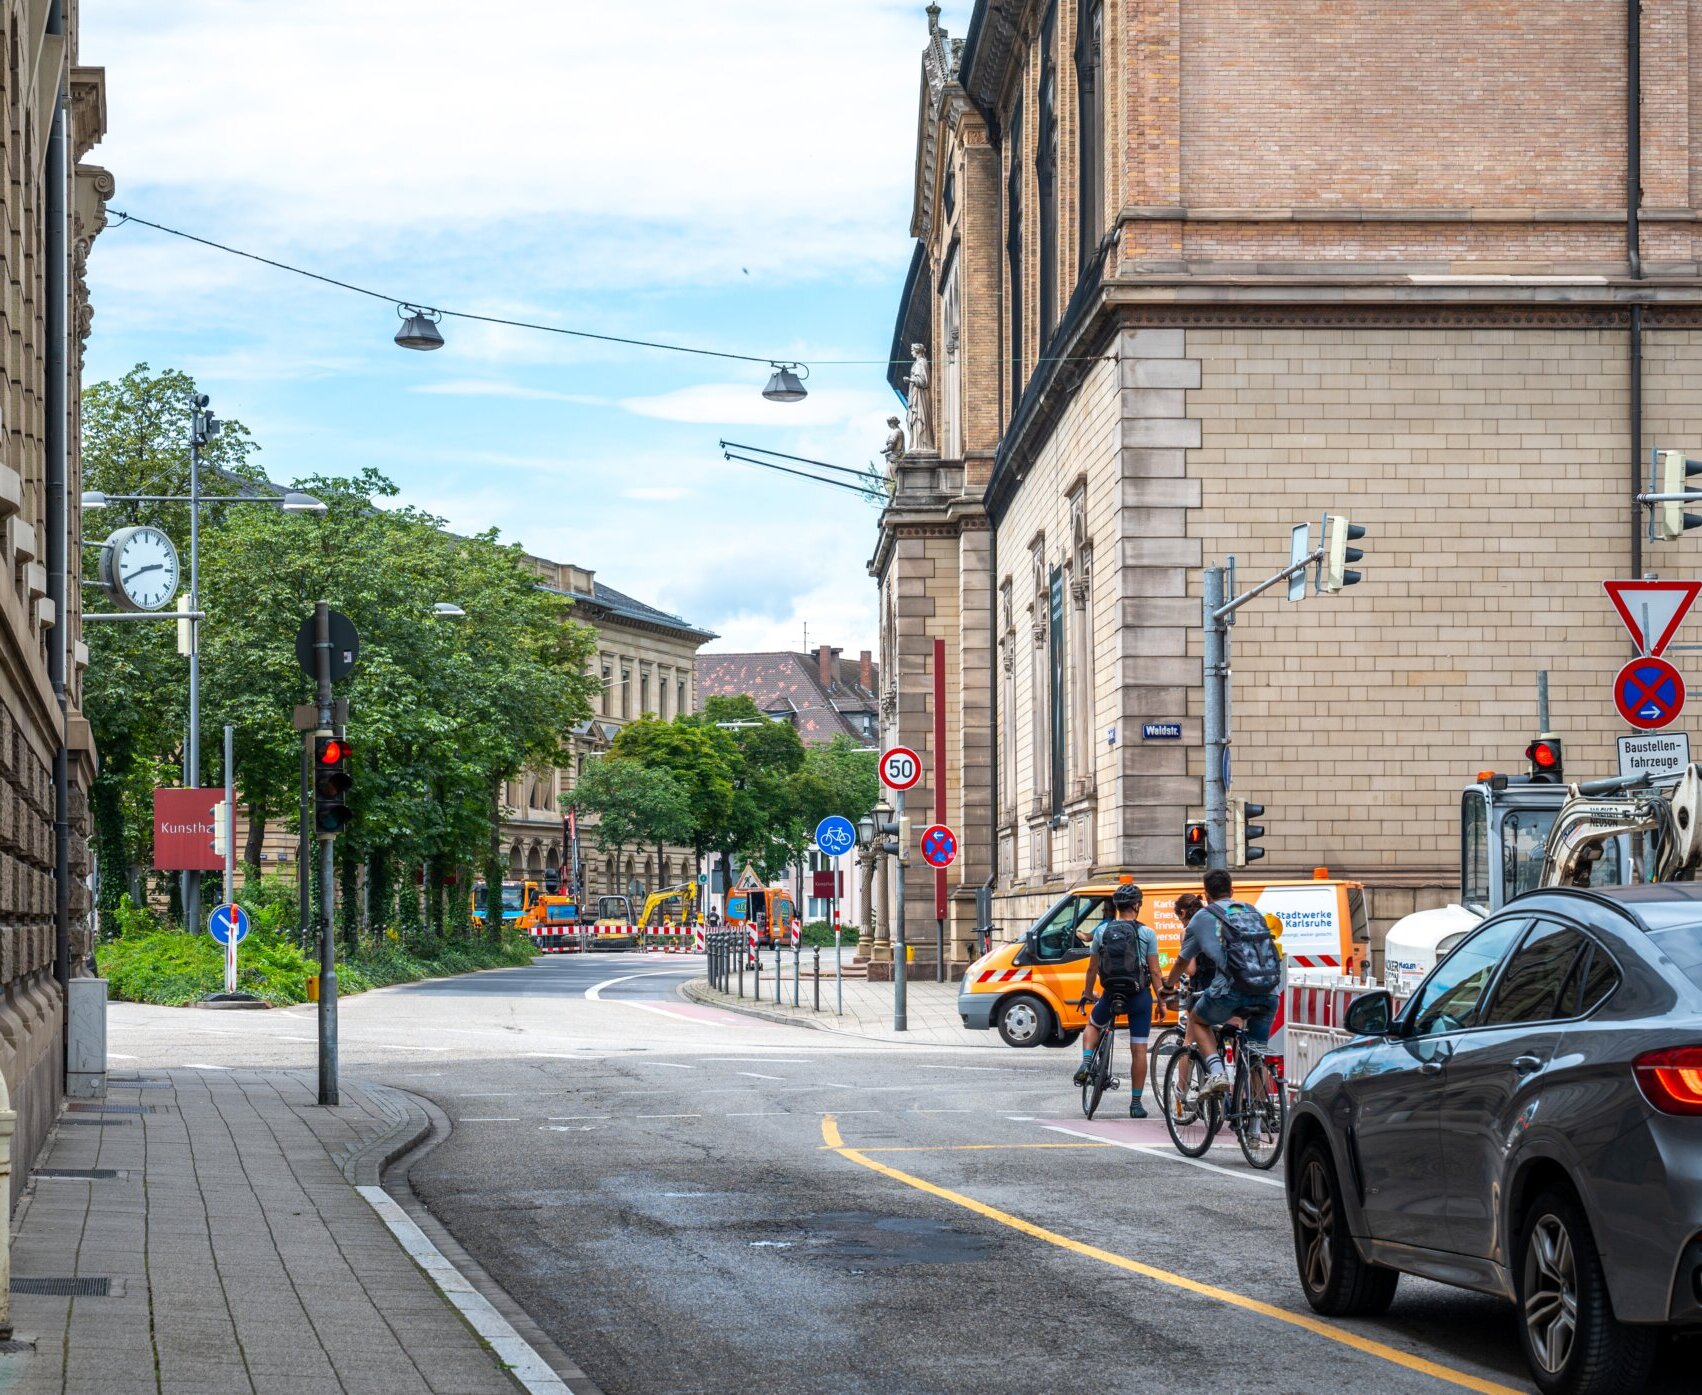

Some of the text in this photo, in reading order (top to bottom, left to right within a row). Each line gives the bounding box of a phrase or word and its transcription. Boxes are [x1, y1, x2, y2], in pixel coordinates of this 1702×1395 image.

[1146, 725, 1179, 736] Waldstr.
[1624, 740, 1682, 754] Baustellen-
[889, 759, 913, 778] 50
[1630, 756, 1678, 769] fahrzeuge
[161, 821, 215, 834] Kunstha
[1275, 910, 1332, 920] Stadtwerke
[1285, 919, 1332, 928] Karlsruhe
